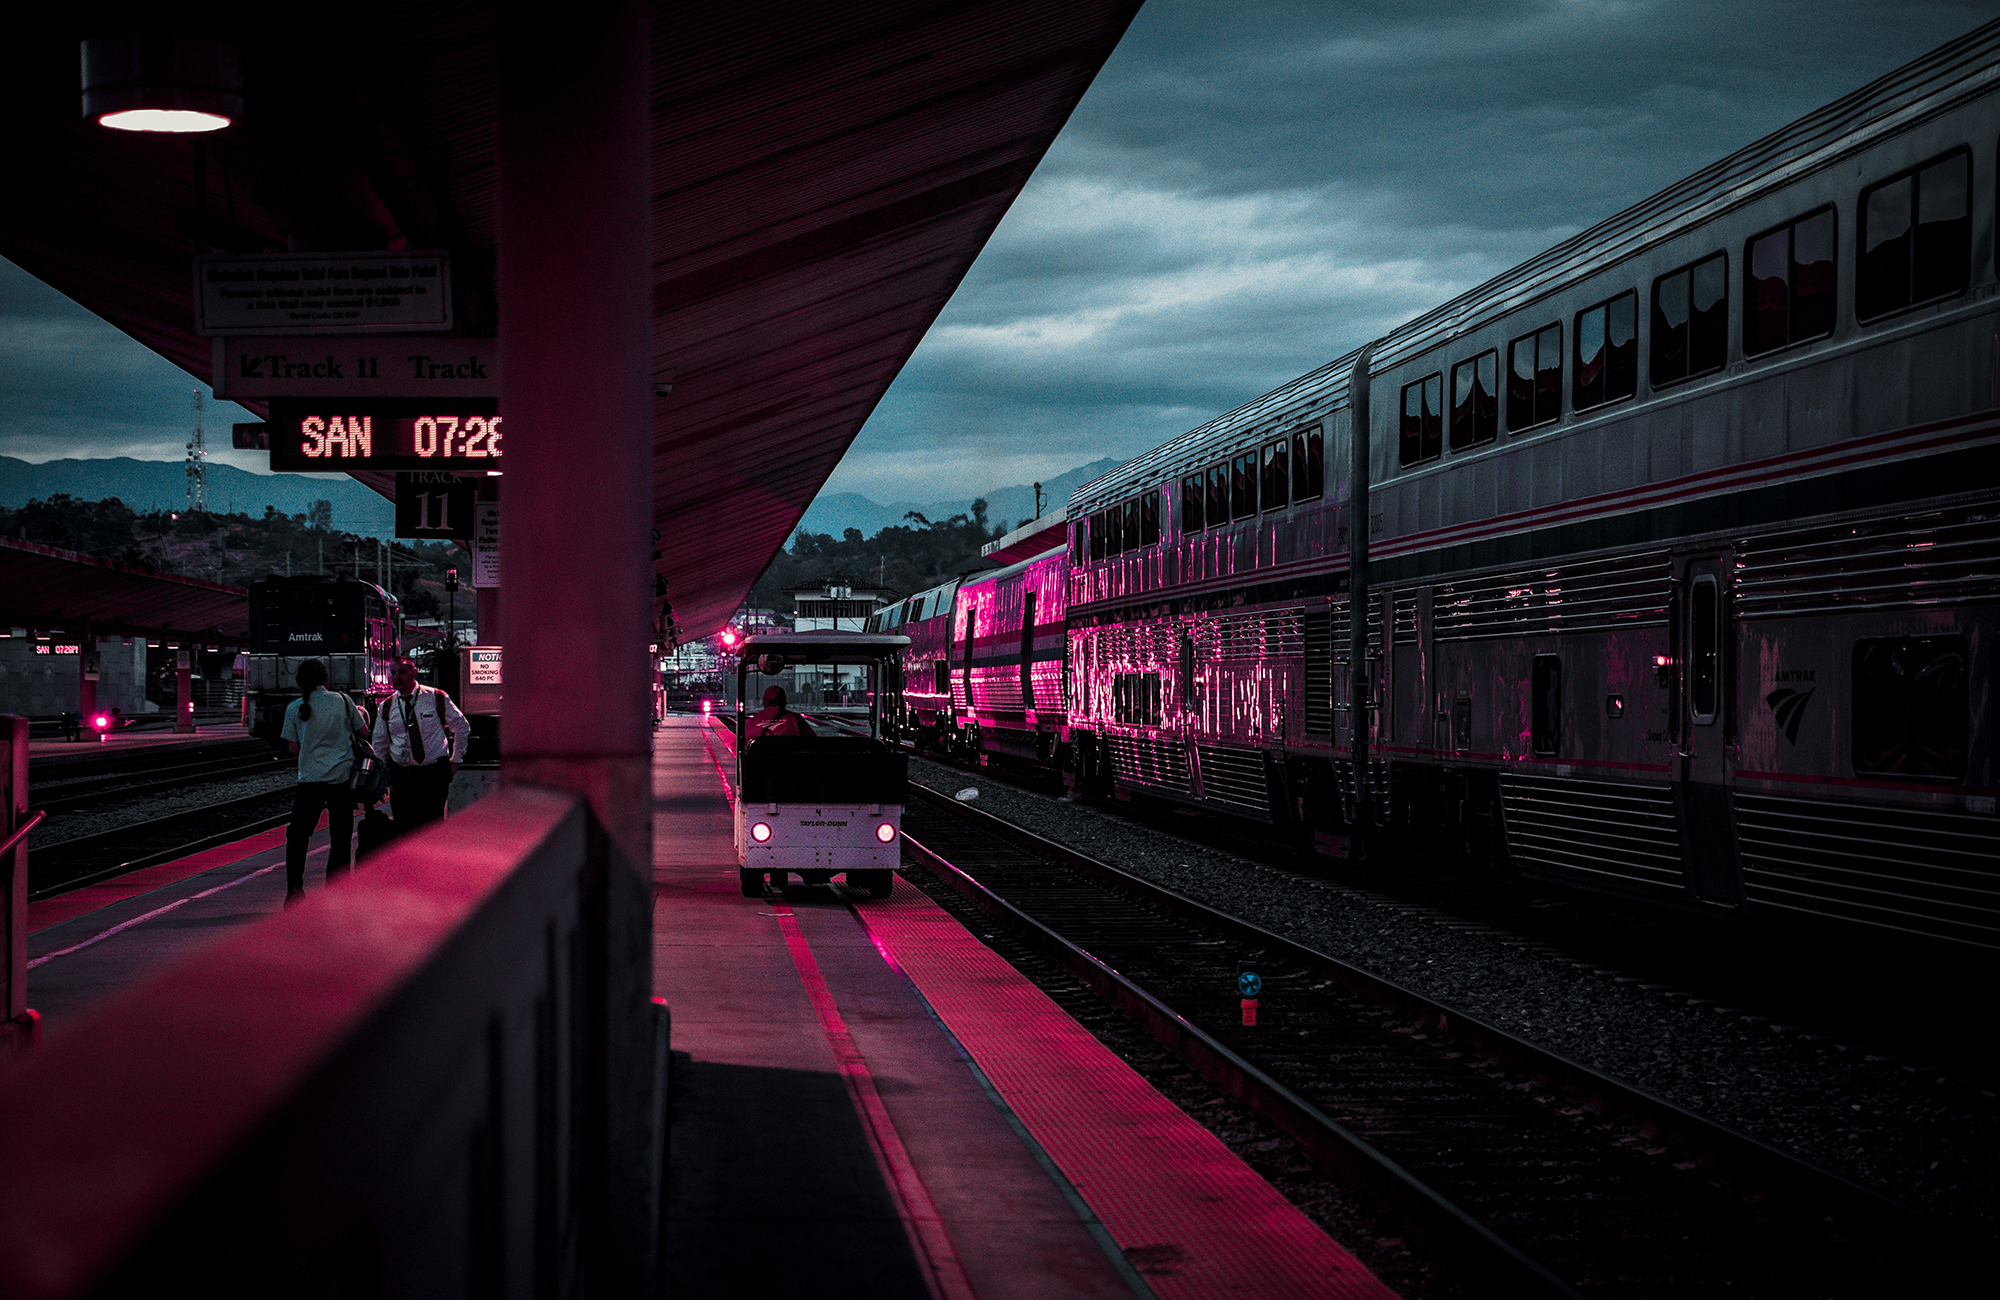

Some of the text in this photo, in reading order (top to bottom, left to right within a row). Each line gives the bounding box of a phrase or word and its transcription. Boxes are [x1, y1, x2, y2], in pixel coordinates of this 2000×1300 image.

[257, 268, 300, 283] Requires
[302, 268, 325, 280] Valid
[328, 267, 349, 279] Fare
[351, 266, 387, 281] Beyond
[389, 265, 410, 278] This
[412, 265, 437, 278] Point
[220, 289, 262, 298] Persons
[265, 289, 304, 297] without
[307, 287, 330, 296] valid
[333, 287, 353, 295] fare
[375, 286, 413, 296] subject
[415, 285, 426, 294] to
[256, 301, 276, 309] fine
[279, 301, 299, 309] that
[302, 301, 323, 309] may
[326, 299, 363, 308] exceed
[264, 356, 487, 379] Track 11 Track
[302, 415, 371, 458] SAN
[407, 471, 463, 484] TRACK
[415, 491, 454, 530] 11
[288, 632, 323, 642] Amtrak
[1775, 671, 1816, 682] AMTRAK
